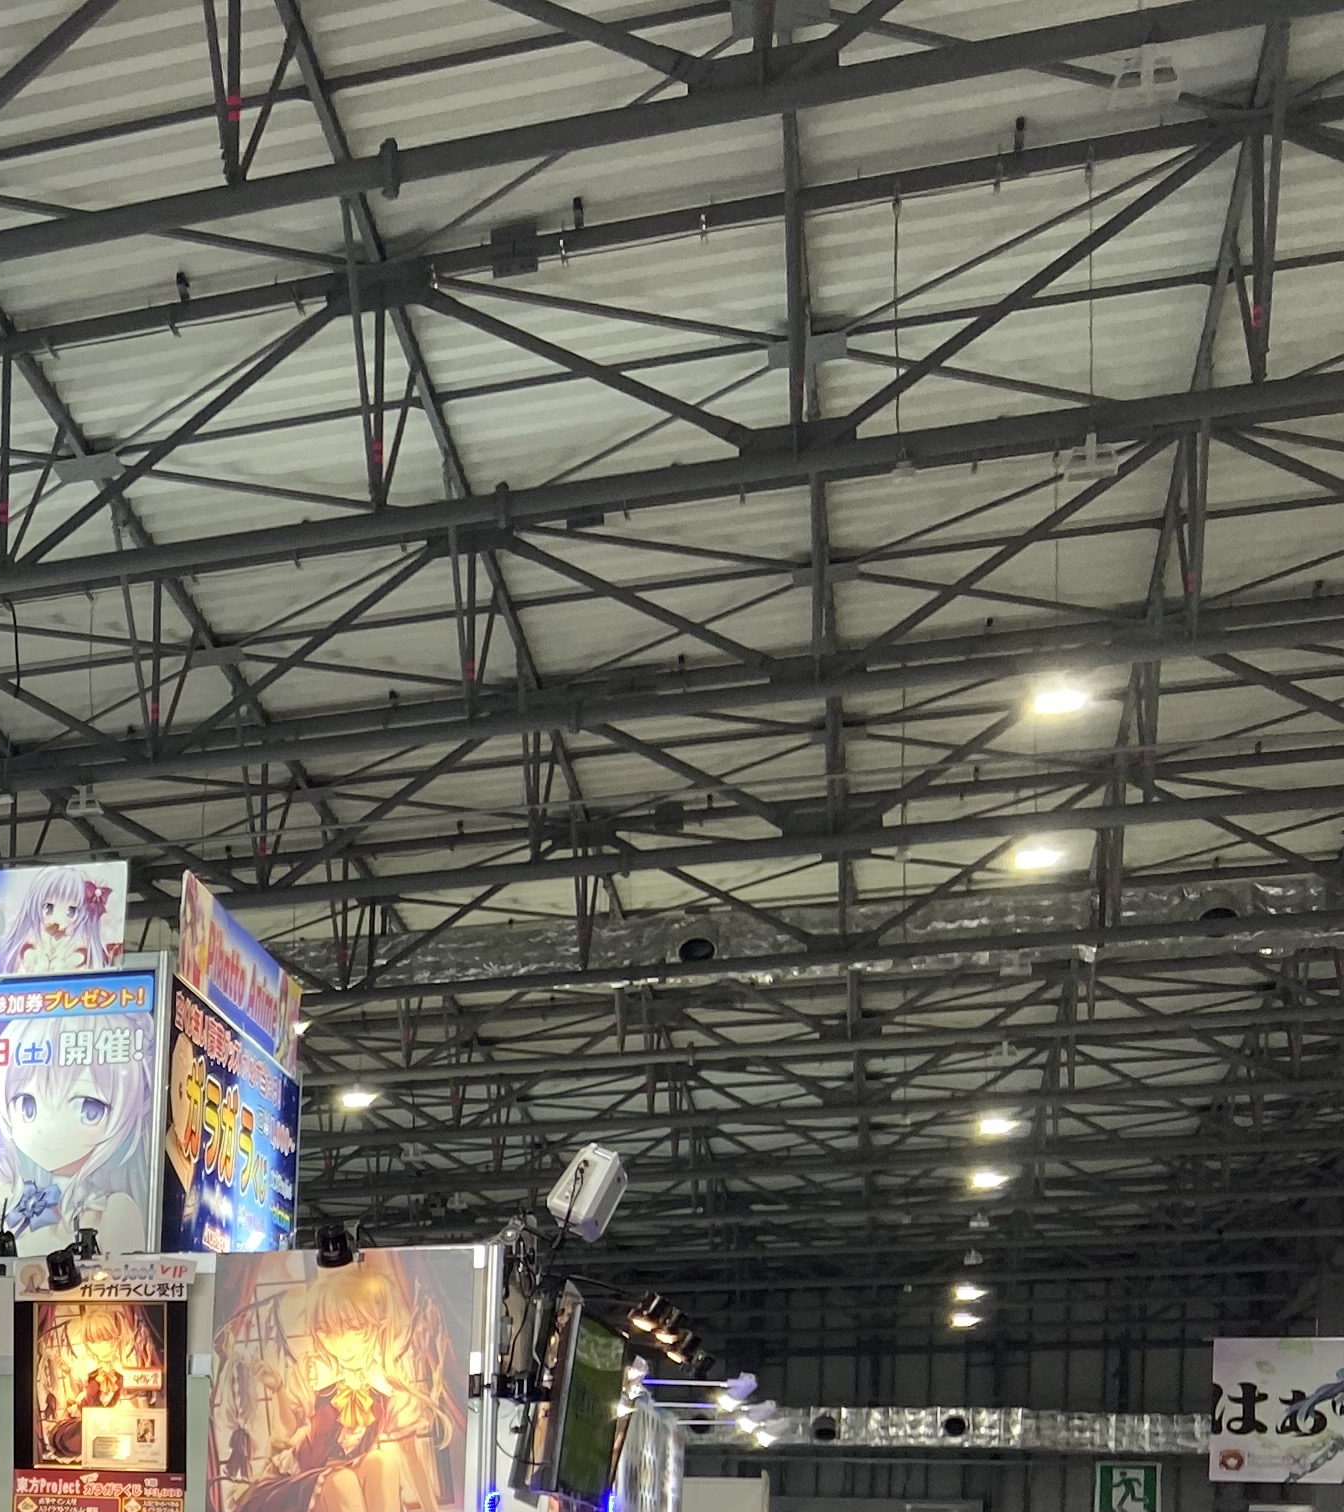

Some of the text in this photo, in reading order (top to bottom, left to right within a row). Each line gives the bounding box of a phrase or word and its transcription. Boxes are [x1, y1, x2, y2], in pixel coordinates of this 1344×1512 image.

[14, 1039, 53, 1067] (土)
[59, 1028, 145, 1068] 開催!
[160, 1264, 189, 1279] VIP
[80, 1283, 185, 1298] ガラガラくじ受付
[16, 1476, 81, 1495] 東方Project
